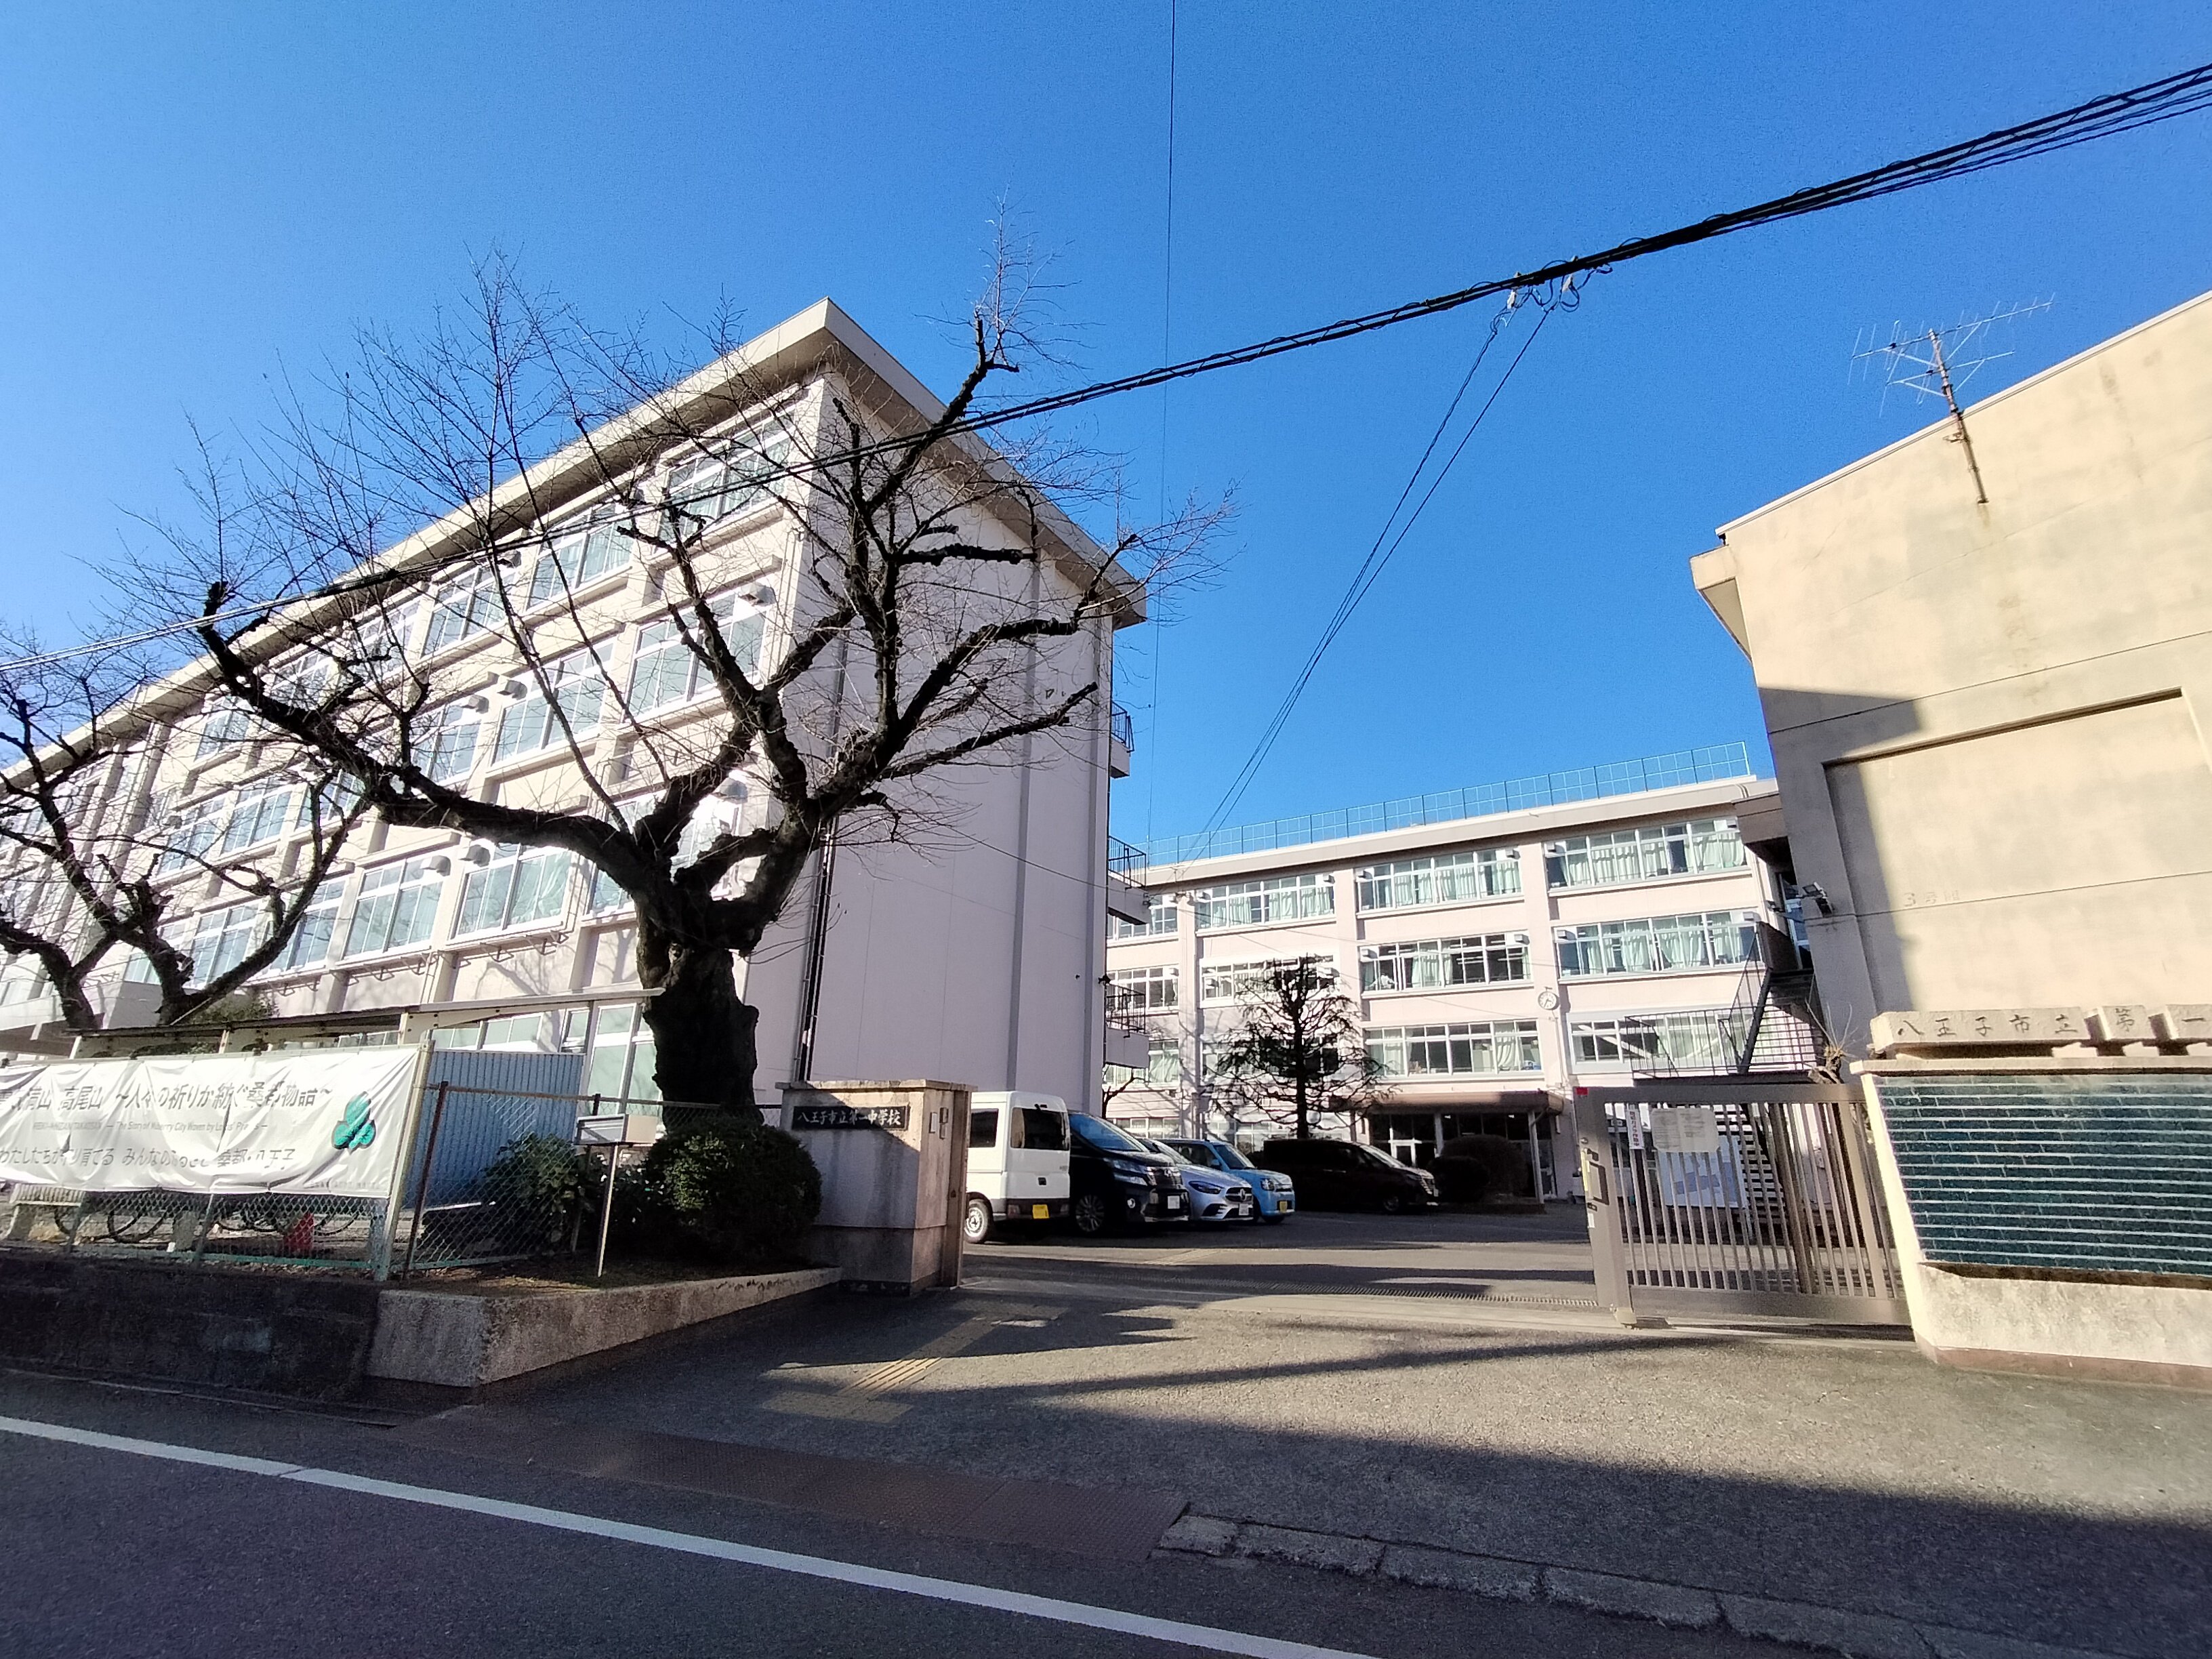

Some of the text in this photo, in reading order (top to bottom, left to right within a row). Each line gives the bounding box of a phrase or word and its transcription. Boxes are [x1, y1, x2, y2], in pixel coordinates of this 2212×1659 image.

[58, 1086, 103, 1110] 高尾山
[798, 1109, 901, 1126] 八王子市立第一中学校
